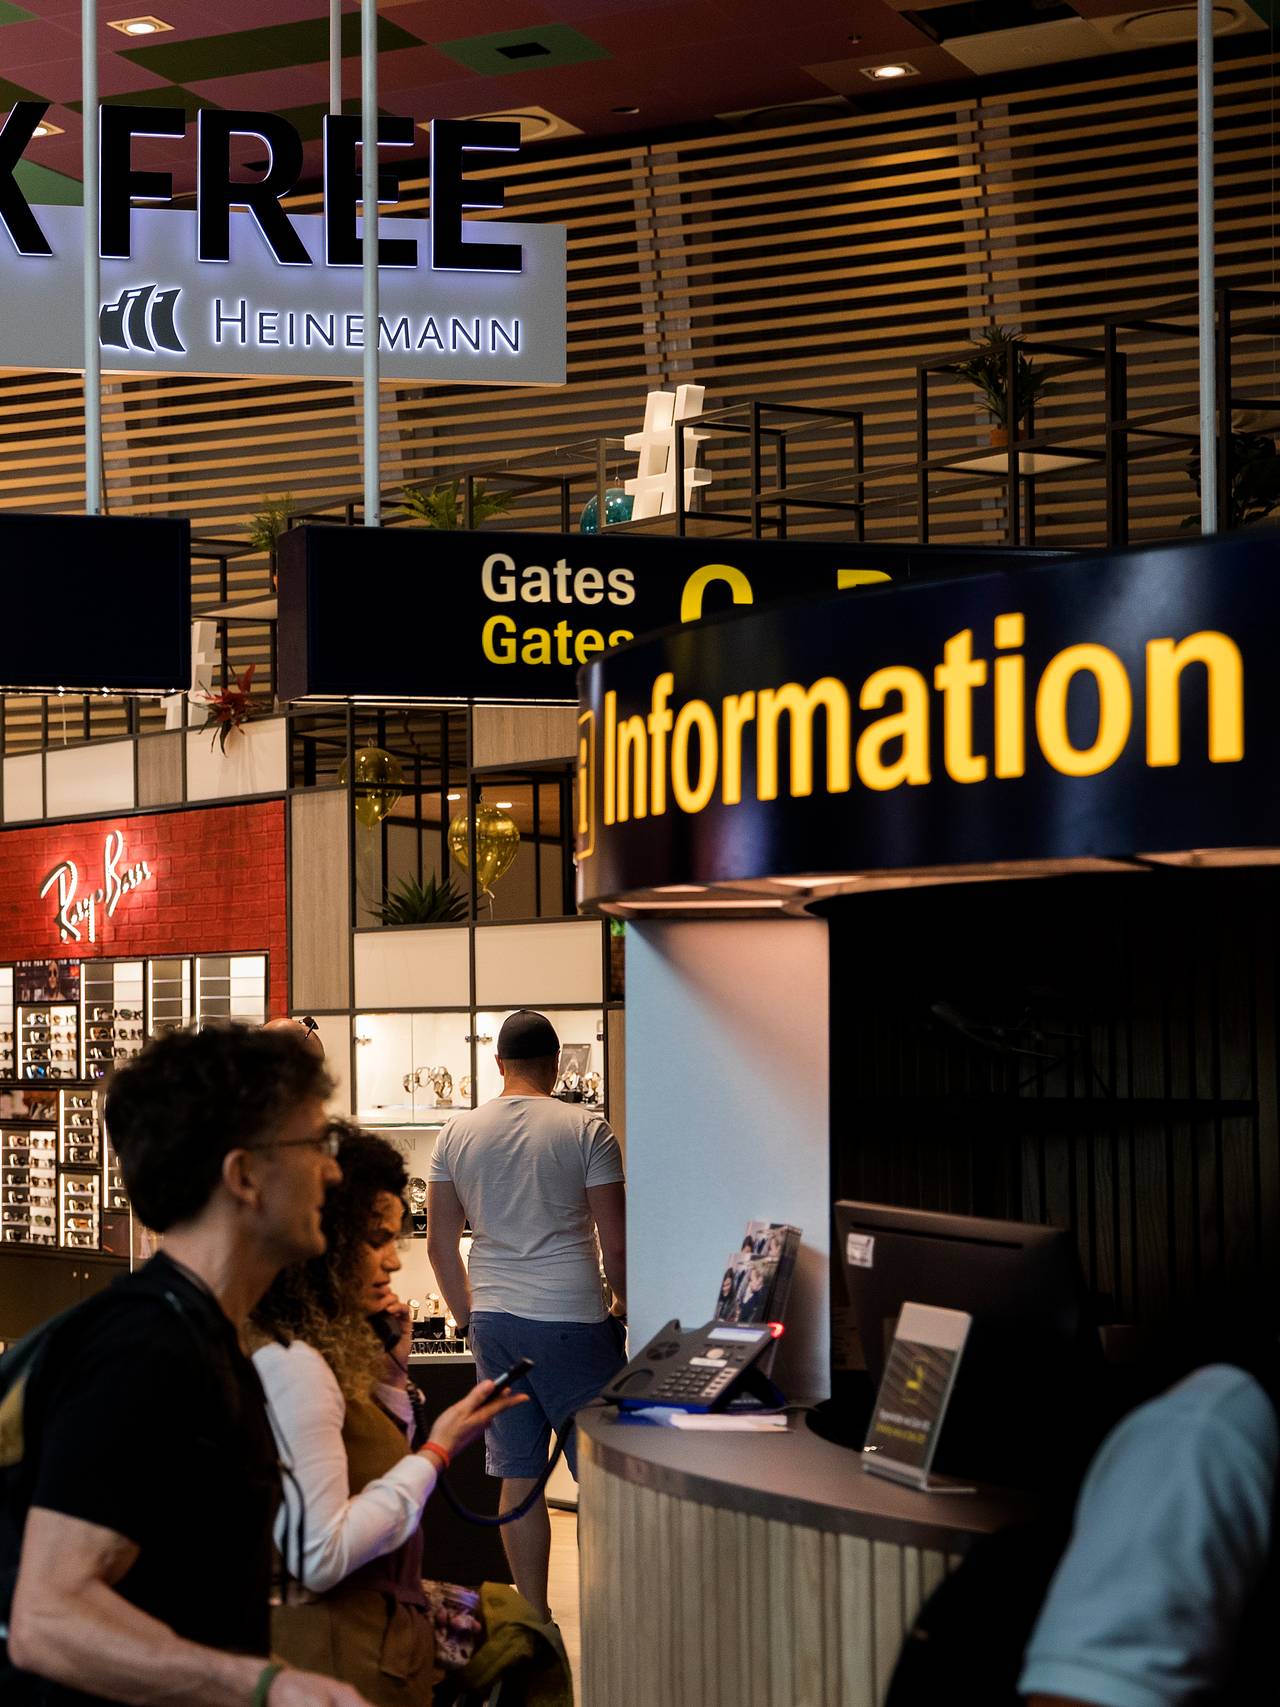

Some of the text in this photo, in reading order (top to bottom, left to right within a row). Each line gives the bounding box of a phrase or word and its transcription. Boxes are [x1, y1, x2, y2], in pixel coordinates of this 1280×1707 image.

[98, 104, 523, 273] FREE
[480, 552, 636, 606] Gates
[603, 611, 1246, 826] Information
